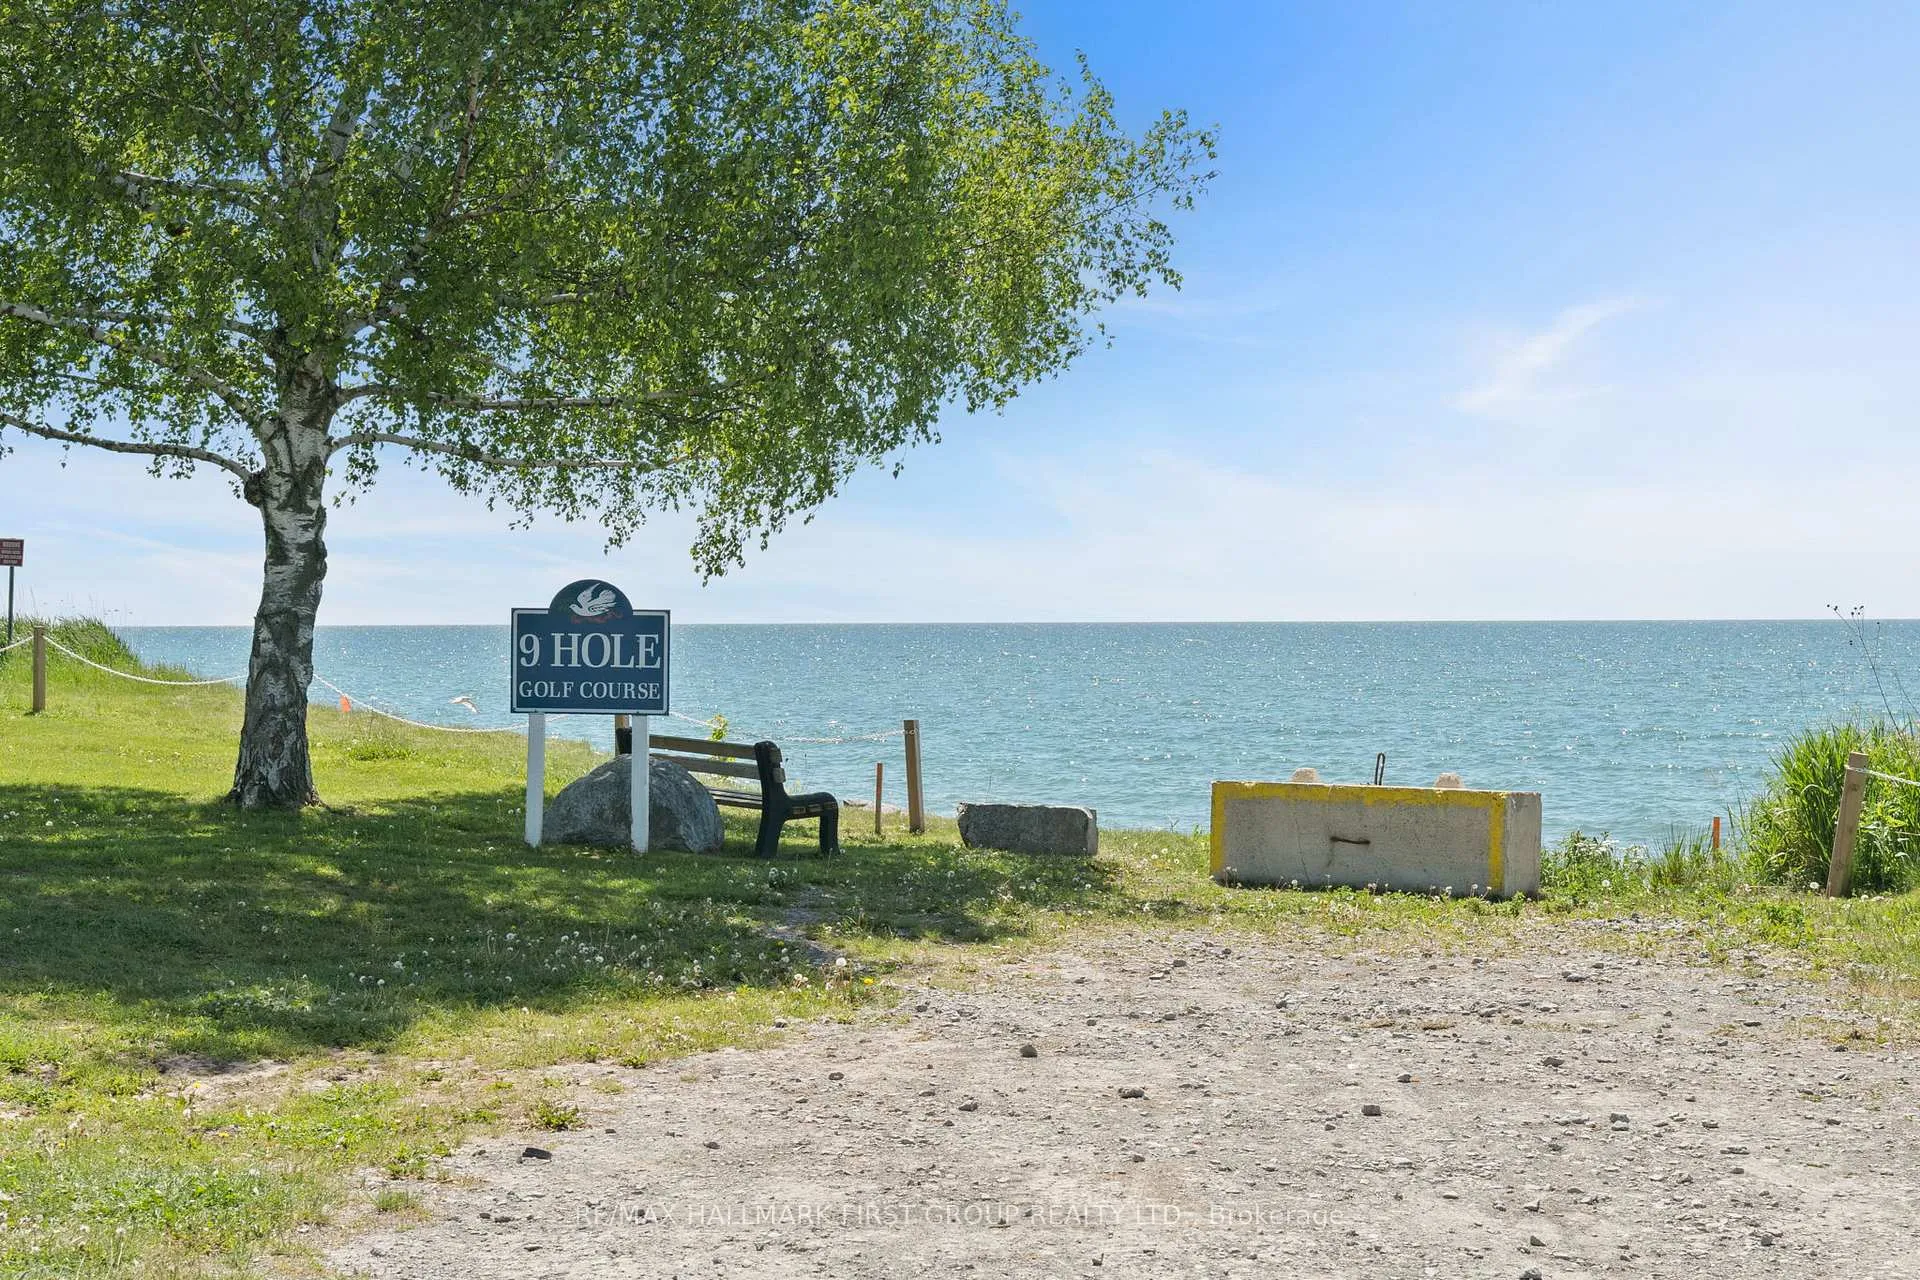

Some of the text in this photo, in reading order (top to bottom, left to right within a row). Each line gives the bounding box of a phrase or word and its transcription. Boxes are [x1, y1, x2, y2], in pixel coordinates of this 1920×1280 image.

[519, 632, 661, 669] 9 HOLE
[519, 680, 661, 699] GOLF COURSE
